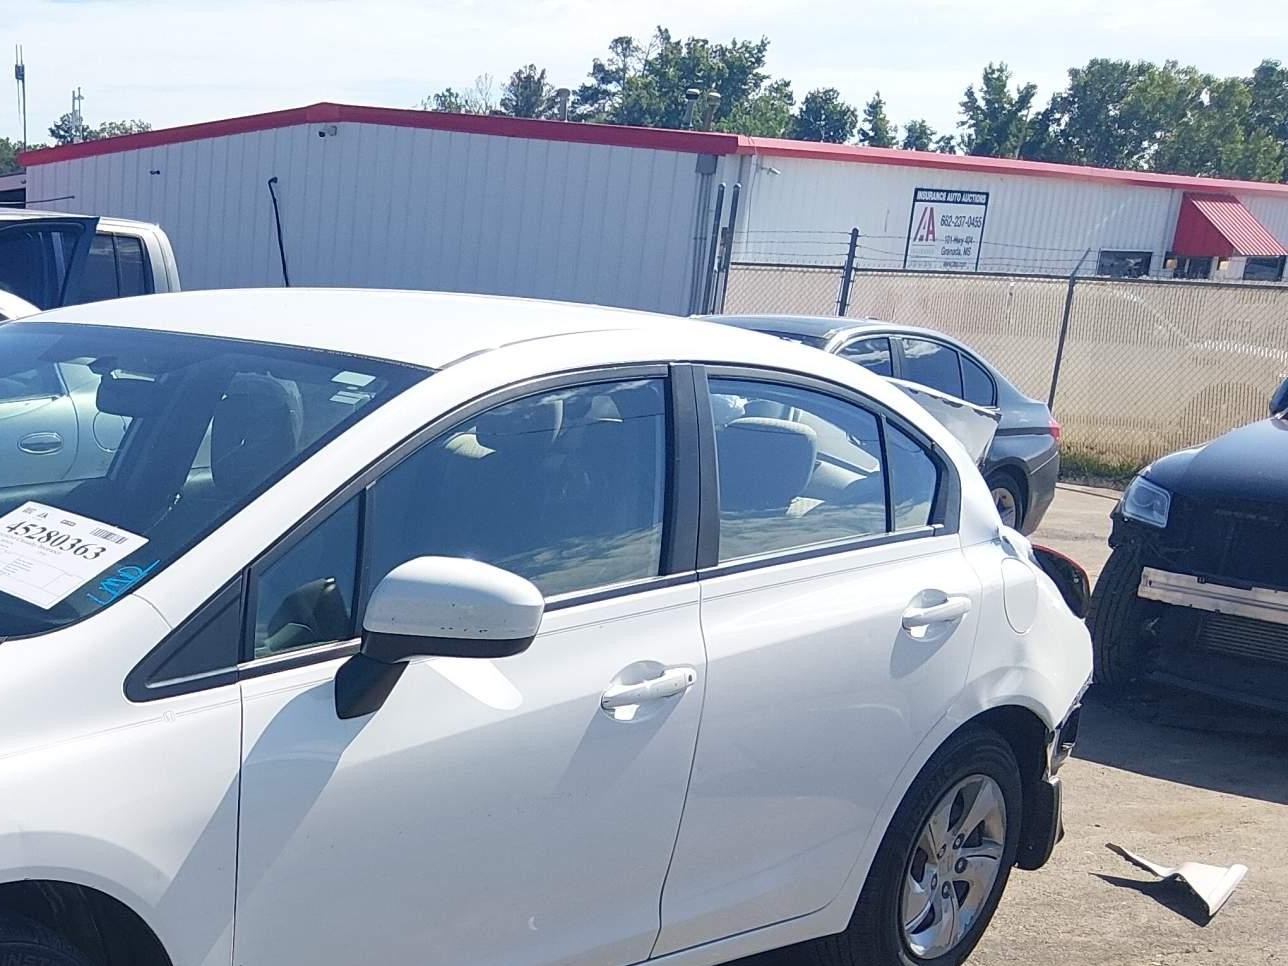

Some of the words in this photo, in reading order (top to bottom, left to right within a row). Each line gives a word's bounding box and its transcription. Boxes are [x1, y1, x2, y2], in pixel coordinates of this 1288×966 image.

[916, 190, 946, 201] INSURANCE
[947, 192, 961, 202] AUTO
[962, 193, 985, 203] AUCTIONS
[940, 214, 982, 228] 662-237-0455
[6, 520, 107, 560] 45280363
